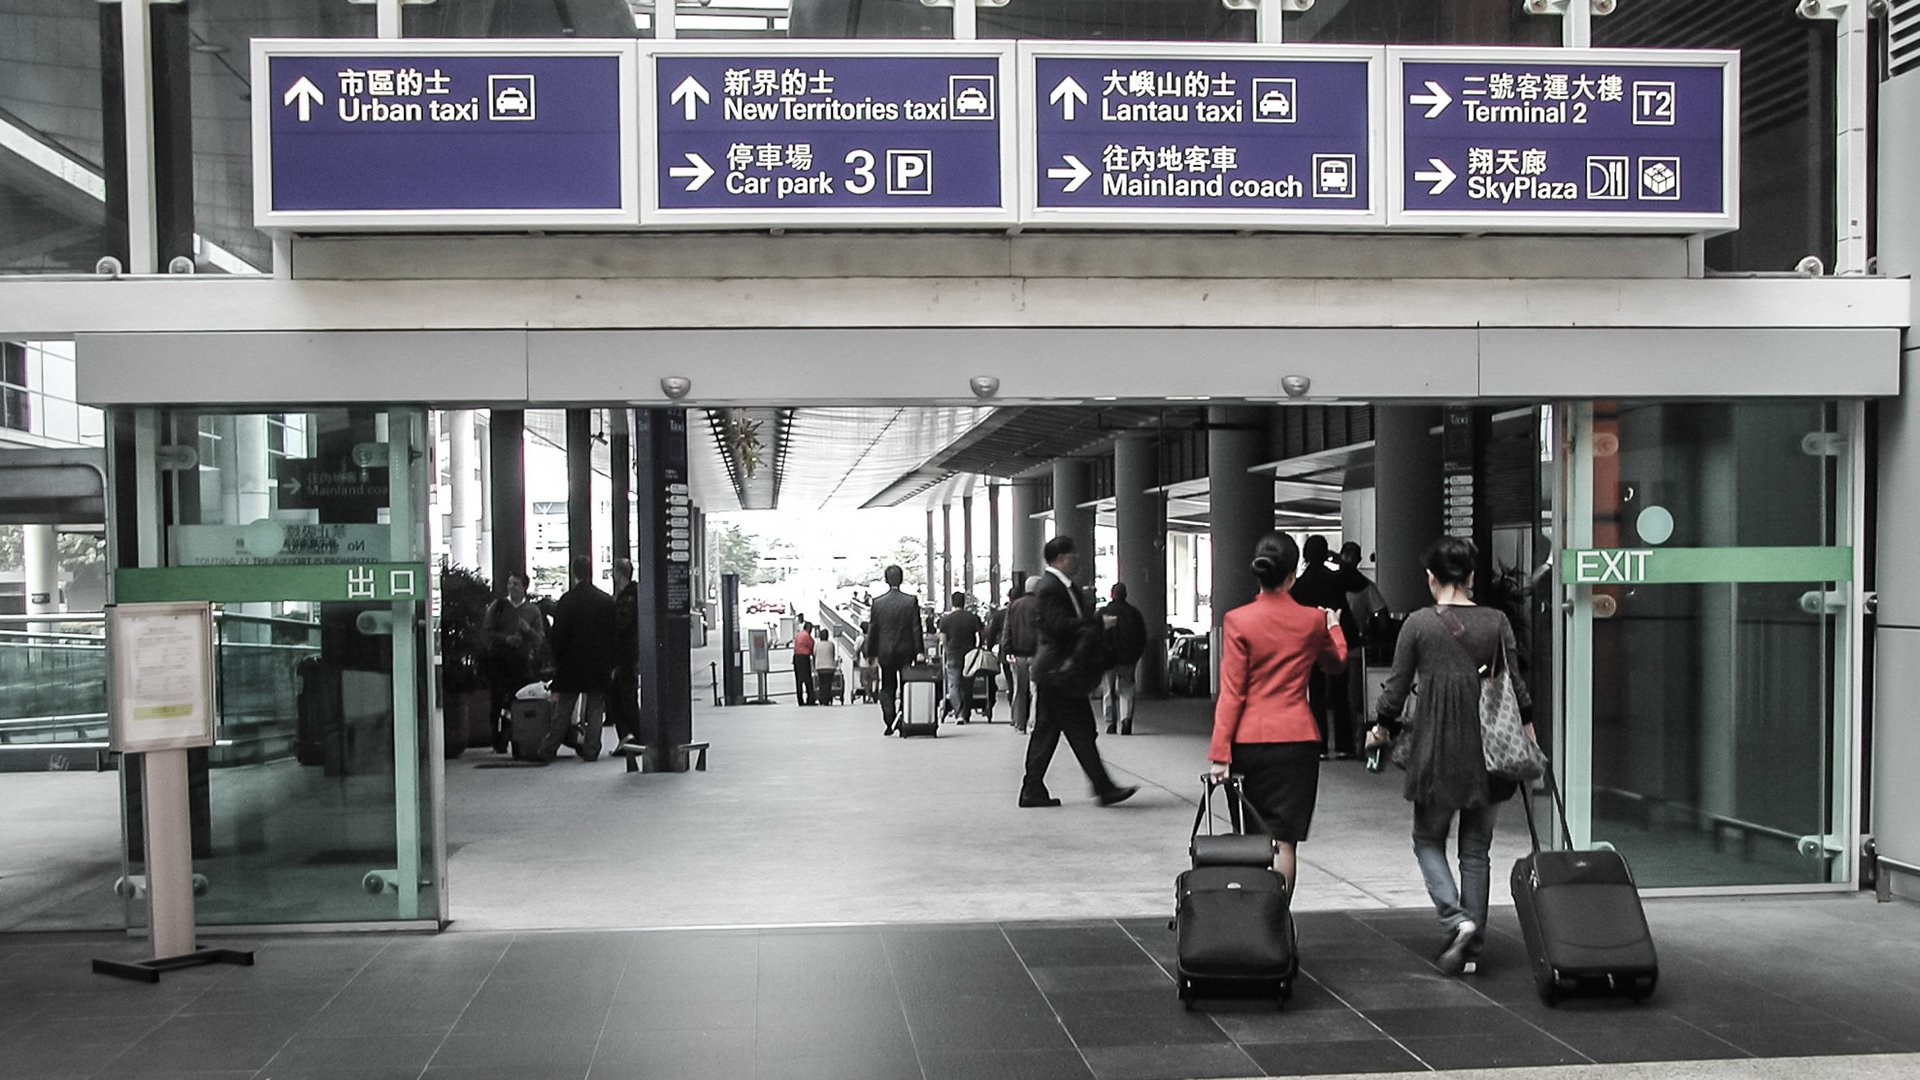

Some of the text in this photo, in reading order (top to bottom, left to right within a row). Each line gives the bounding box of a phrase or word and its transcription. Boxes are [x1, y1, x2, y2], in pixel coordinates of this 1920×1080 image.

[338, 68, 451, 97] 市區的士
[724, 69, 835, 97] 新界的士
[1102, 69, 1236, 98] 大嶼山的士
[1462, 73, 1624, 102] 二號客運大樓
[338, 97, 479, 121] Urban taxi
[724, 97, 947, 121] New Territories taxi
[1102, 98, 1243, 123] Lantau taxi
[1463, 101, 1588, 124] Terminal 2
[1637, 90, 1671, 116] T2
[726, 143, 813, 171] 停車場
[1102, 144, 1238, 173] 往內地客車
[1468, 148, 1547, 176] 翔天廊
[726, 172, 834, 199] Car park
[844, 150, 876, 194] 3
[896, 155, 928, 189] P
[1103, 173, 1303, 198] Mainland coach
[1468, 176, 1578, 203] SkyPlaza
[1576, 550, 1654, 582] EXIT
[348, 566, 414, 598] 出口
